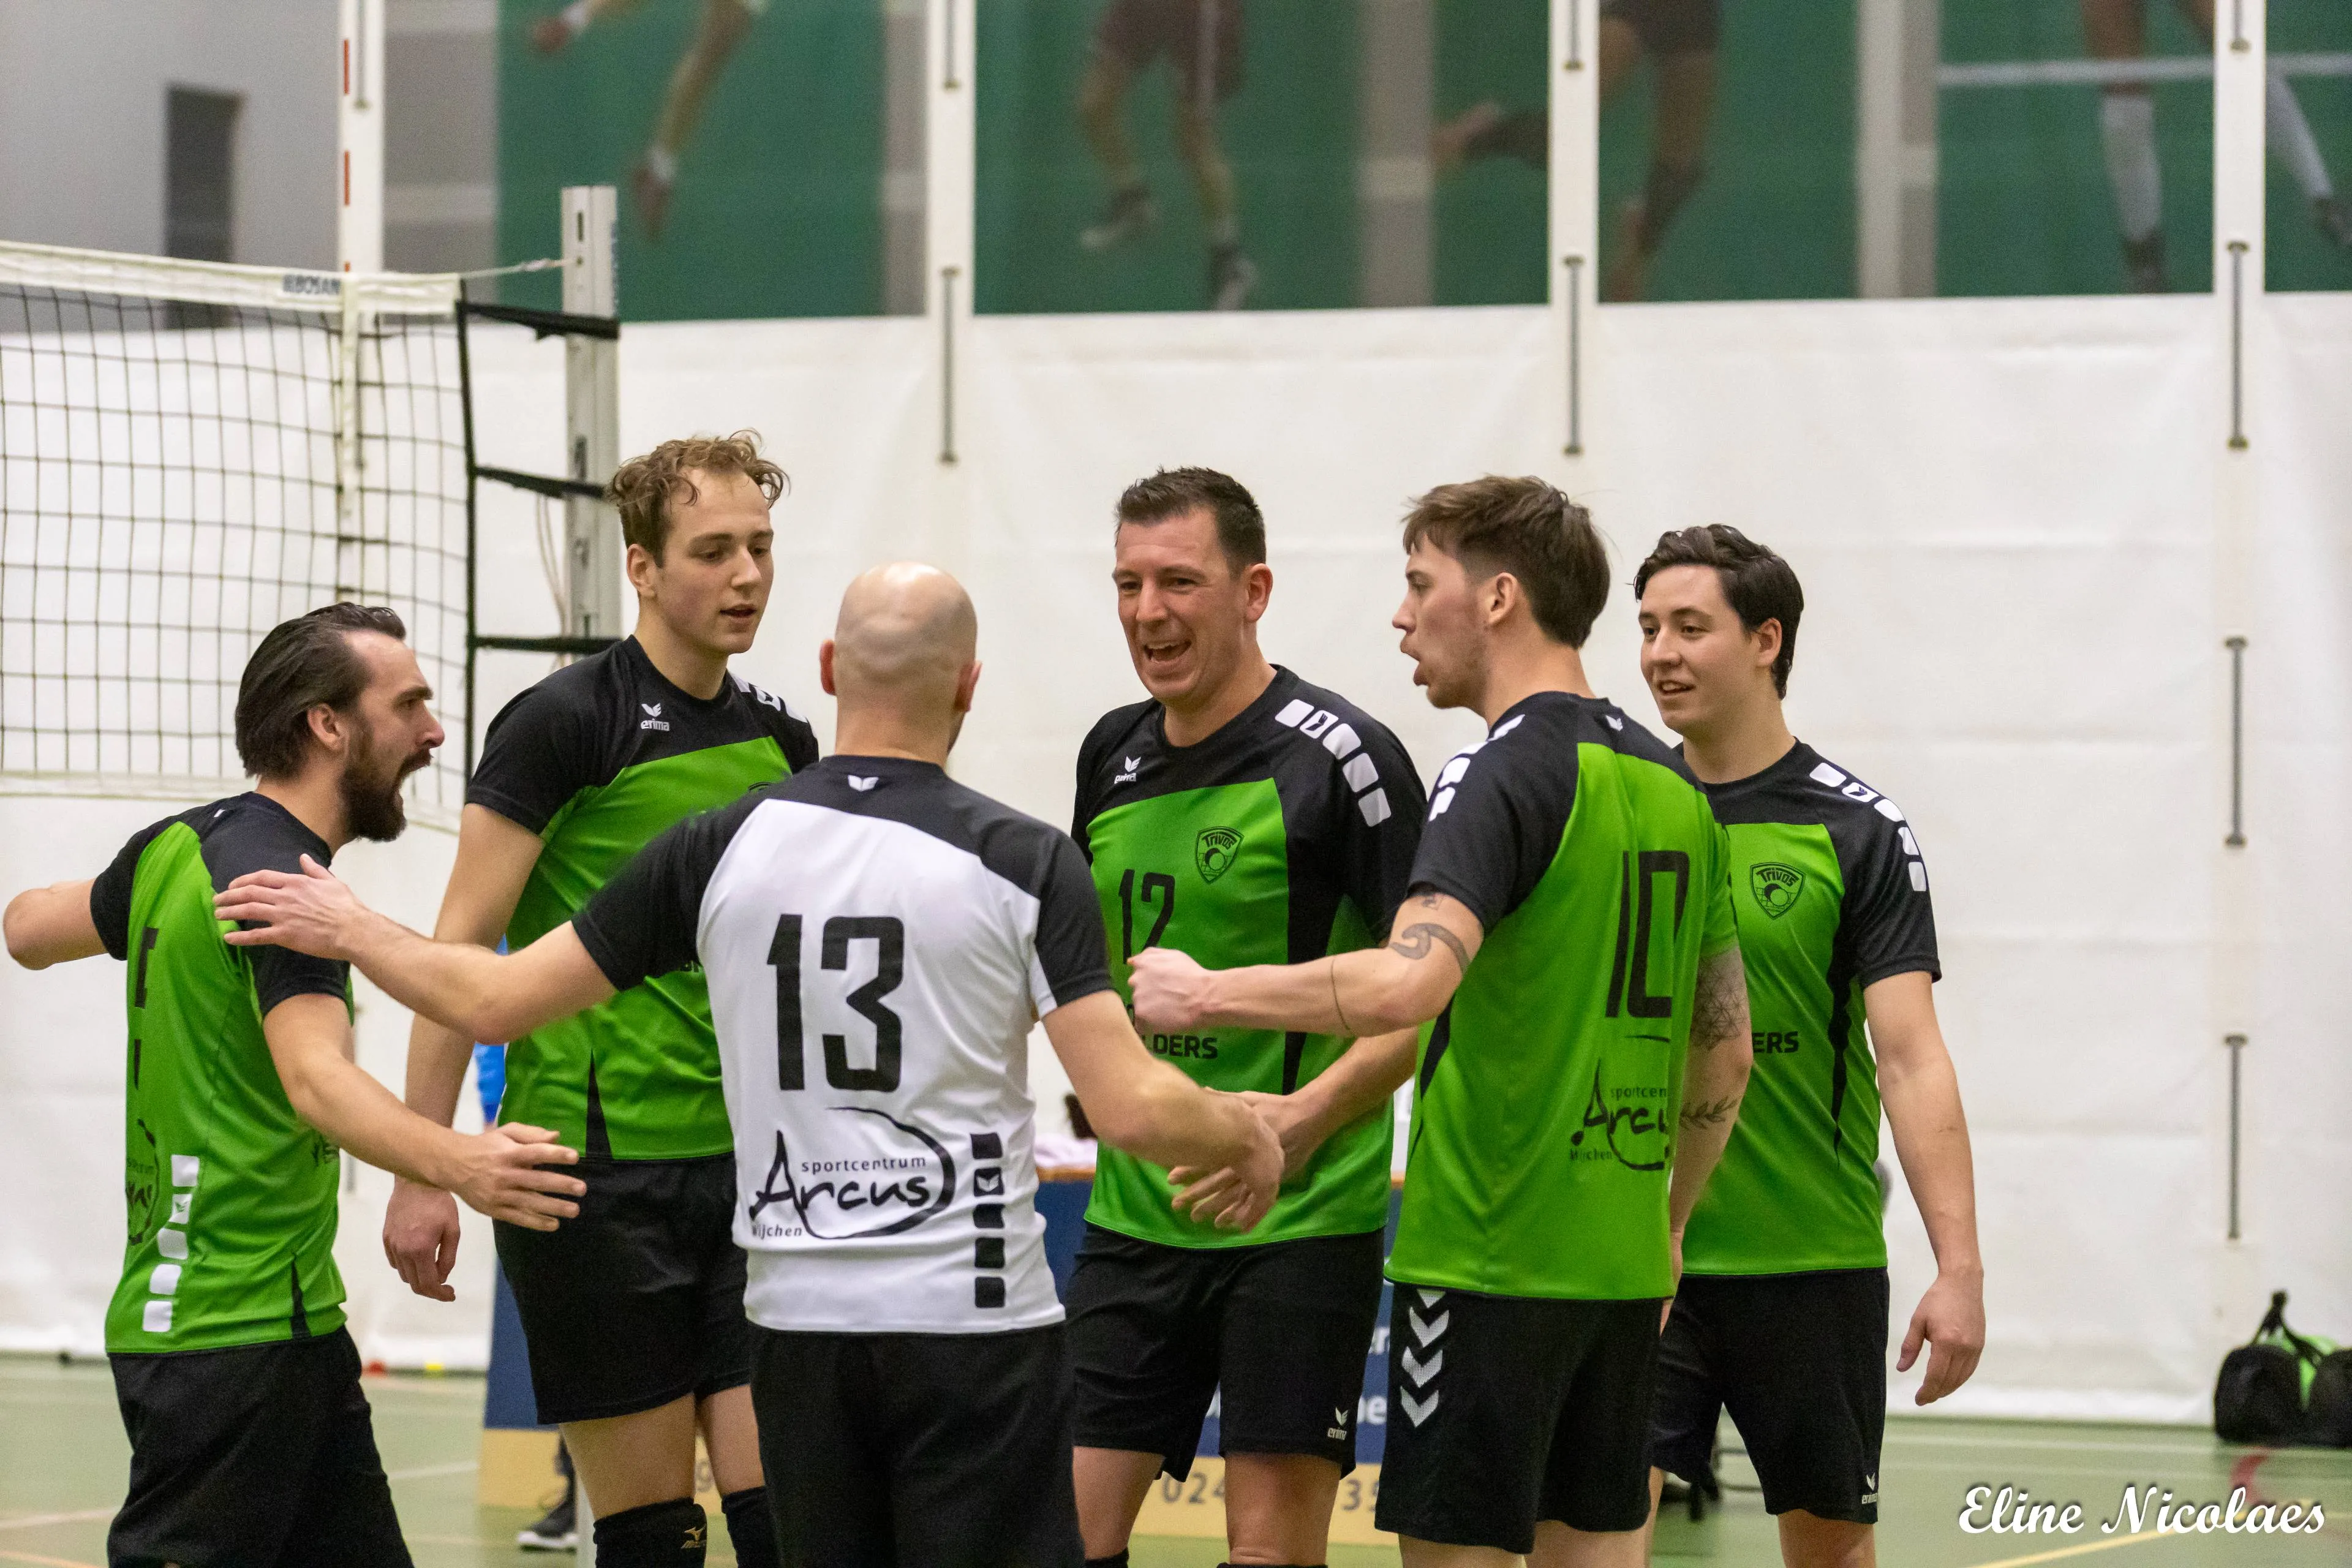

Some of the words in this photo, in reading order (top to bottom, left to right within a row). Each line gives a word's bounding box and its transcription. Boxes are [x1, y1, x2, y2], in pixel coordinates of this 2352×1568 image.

[641, 718, 670, 731] erima
[1755, 867, 1800, 887] Trivos
[1119, 869, 1175, 964] 12
[767, 914, 904, 1093] 13
[1142, 1034, 1218, 1059] DERS
[1611, 1087, 1668, 1101] sportcen
[749, 1130, 930, 1221] Arcus
[802, 1156, 926, 1174] sportcentrum
